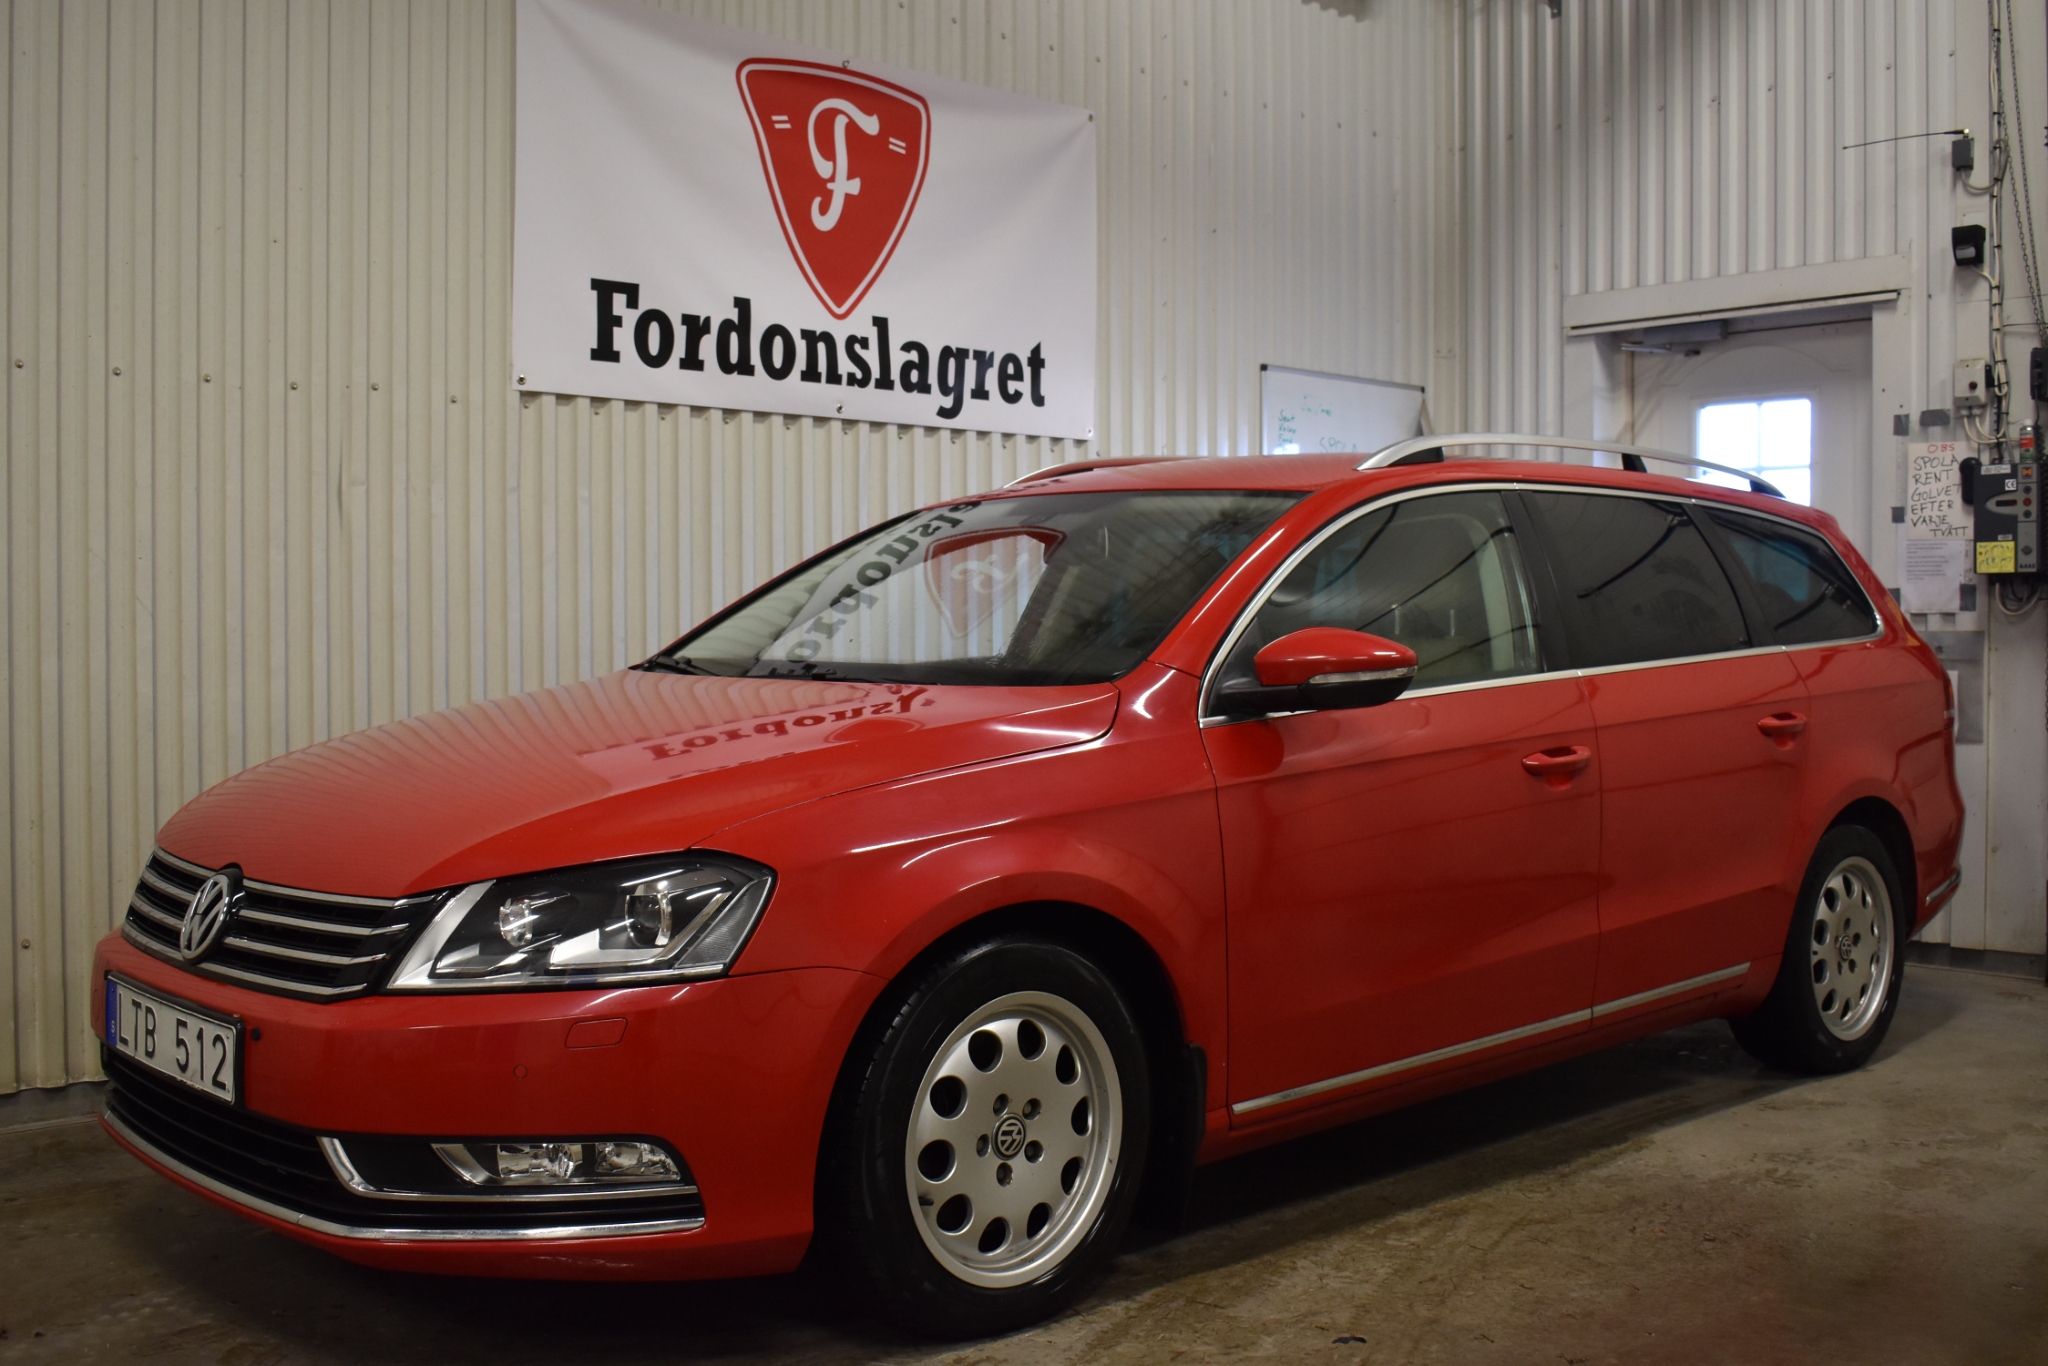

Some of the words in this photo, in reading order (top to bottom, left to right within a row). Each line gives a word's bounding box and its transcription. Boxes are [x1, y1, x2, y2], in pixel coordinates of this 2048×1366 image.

[589, 277, 1046, 420] Fordonslagret
[1927, 443, 1956, 454] OBS
[1913, 453, 1960, 471] SPOLA
[1912, 468, 1954, 486] RENT
[1911, 483, 1962, 502] GOLVET
[1911, 499, 1954, 515] EFTER
[1910, 514, 1950, 527] VARJE
[1929, 523, 1969, 537] TVÄTT
[118, 991, 157, 1059] LTB
[175, 1016, 227, 1091] 512
